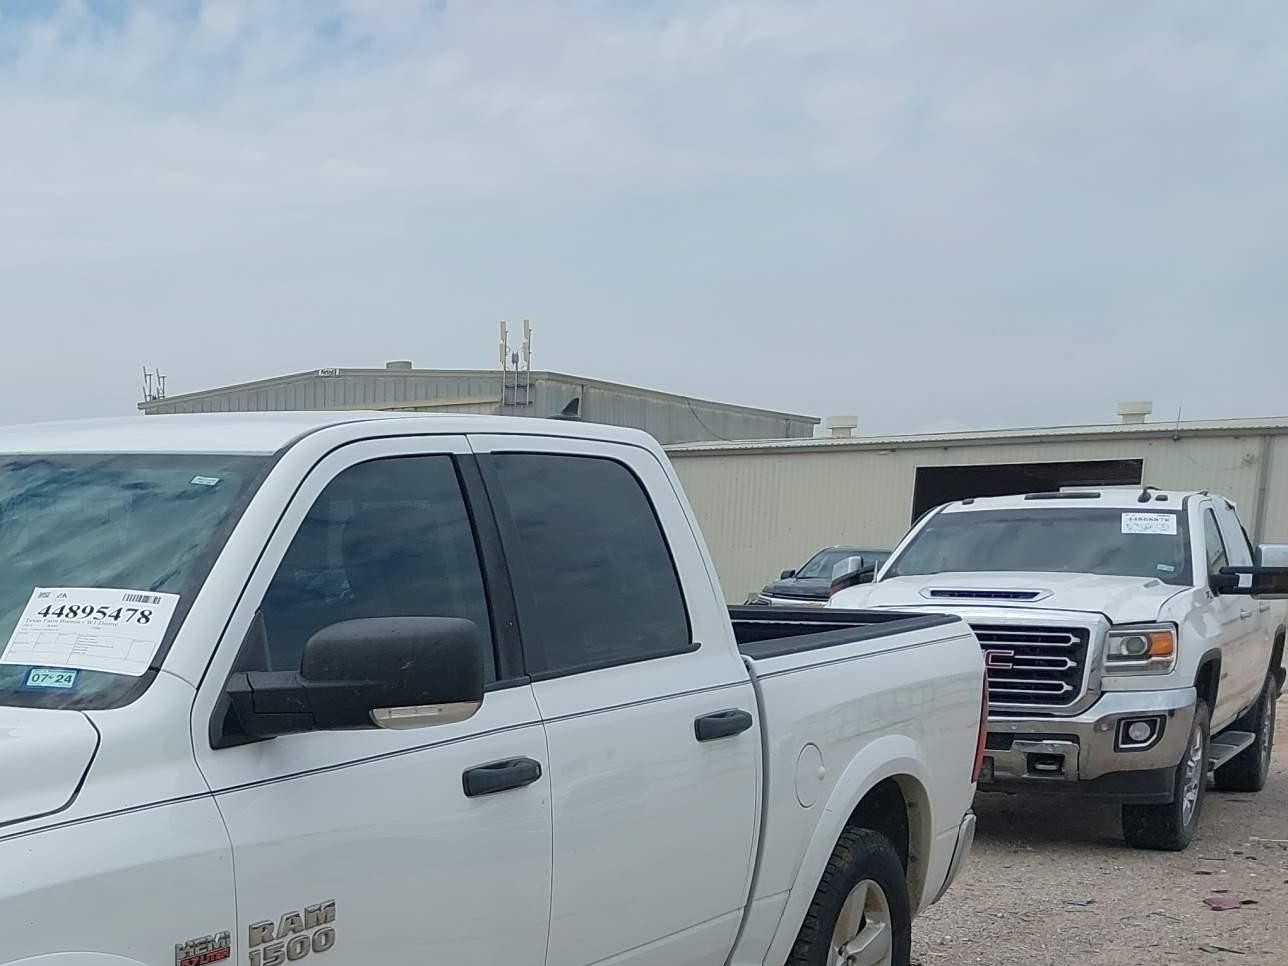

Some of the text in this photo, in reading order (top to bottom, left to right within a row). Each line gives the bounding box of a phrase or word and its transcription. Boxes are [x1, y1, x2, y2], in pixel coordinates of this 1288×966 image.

[38, 604, 153, 625] 44895478
[249, 898, 337, 948] RAM
[175, 930, 231, 966] HEMI
